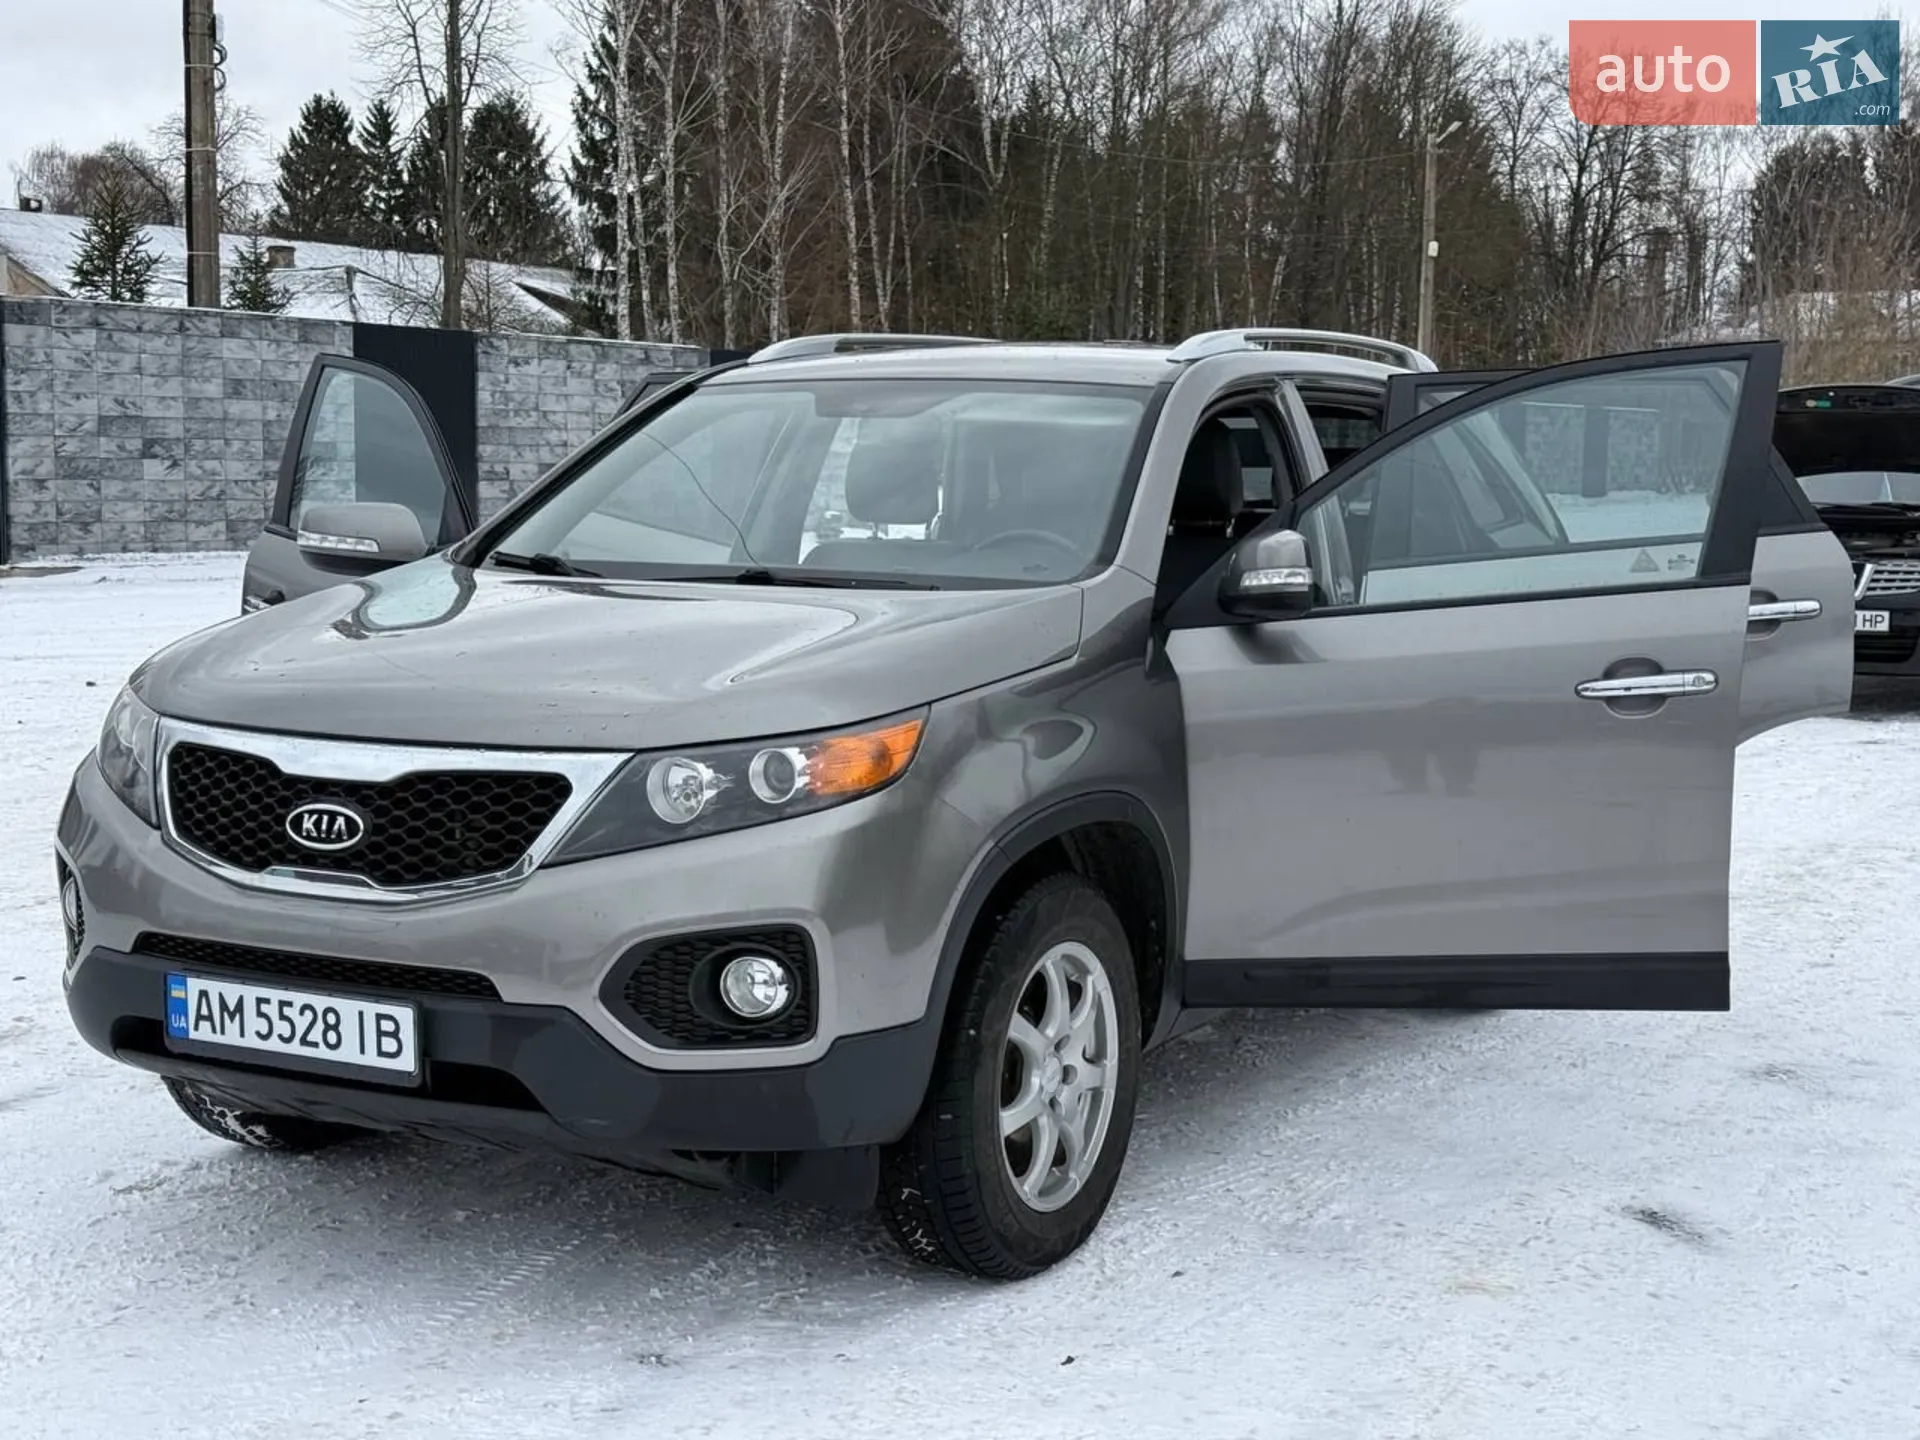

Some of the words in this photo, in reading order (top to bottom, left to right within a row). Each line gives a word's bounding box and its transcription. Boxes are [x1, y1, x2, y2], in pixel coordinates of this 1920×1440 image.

[1862, 613, 1885, 628] HP
[302, 812, 348, 840] KIA
[171, 1013, 187, 1029] UA
[193, 989, 245, 1038] AM
[254, 996, 343, 1051] 5528
[358, 1010, 403, 1060] IB
